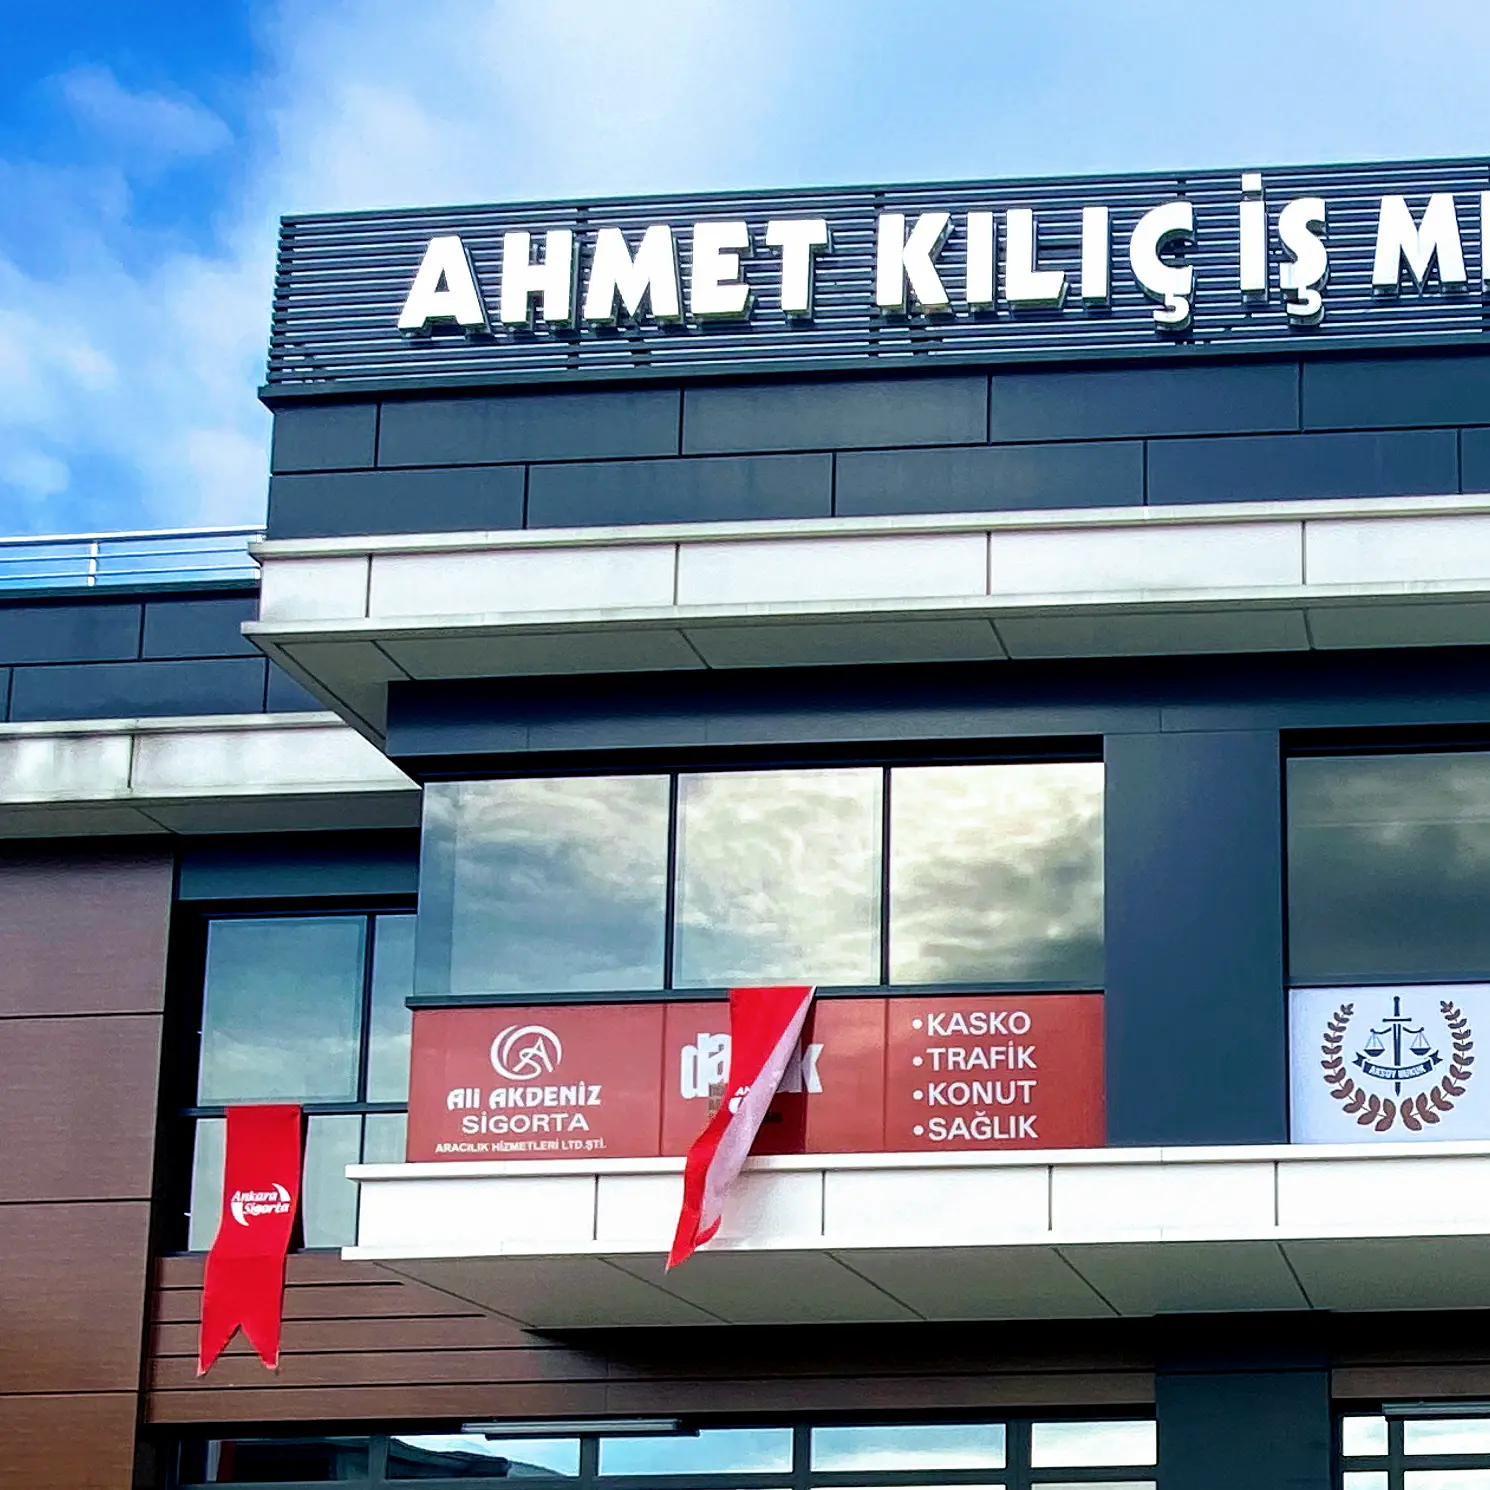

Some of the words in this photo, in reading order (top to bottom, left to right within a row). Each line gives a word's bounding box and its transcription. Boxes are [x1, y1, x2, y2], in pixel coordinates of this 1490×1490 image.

[397, 216, 832, 334] AHMET
[875, 200, 1196, 333] KILIÇ
[1240, 172, 1330, 328] İŞ
[927, 1011, 1032, 1036] KASKO
[926, 1040, 1038, 1071] TRAFİK
[488, 1080, 603, 1111] AKDENİZ
[928, 1080, 1037, 1106] KONUT
[461, 1110, 590, 1135] SİGORTA
[928, 1110, 1038, 1141] SAĞLIK
[434, 1141, 489, 1154] ARACILIK
[491, 1137, 559, 1152] HİZMETLERİ
[231, 1190, 278, 1202] Ankara
[243, 1202, 290, 1216] Sigorta
